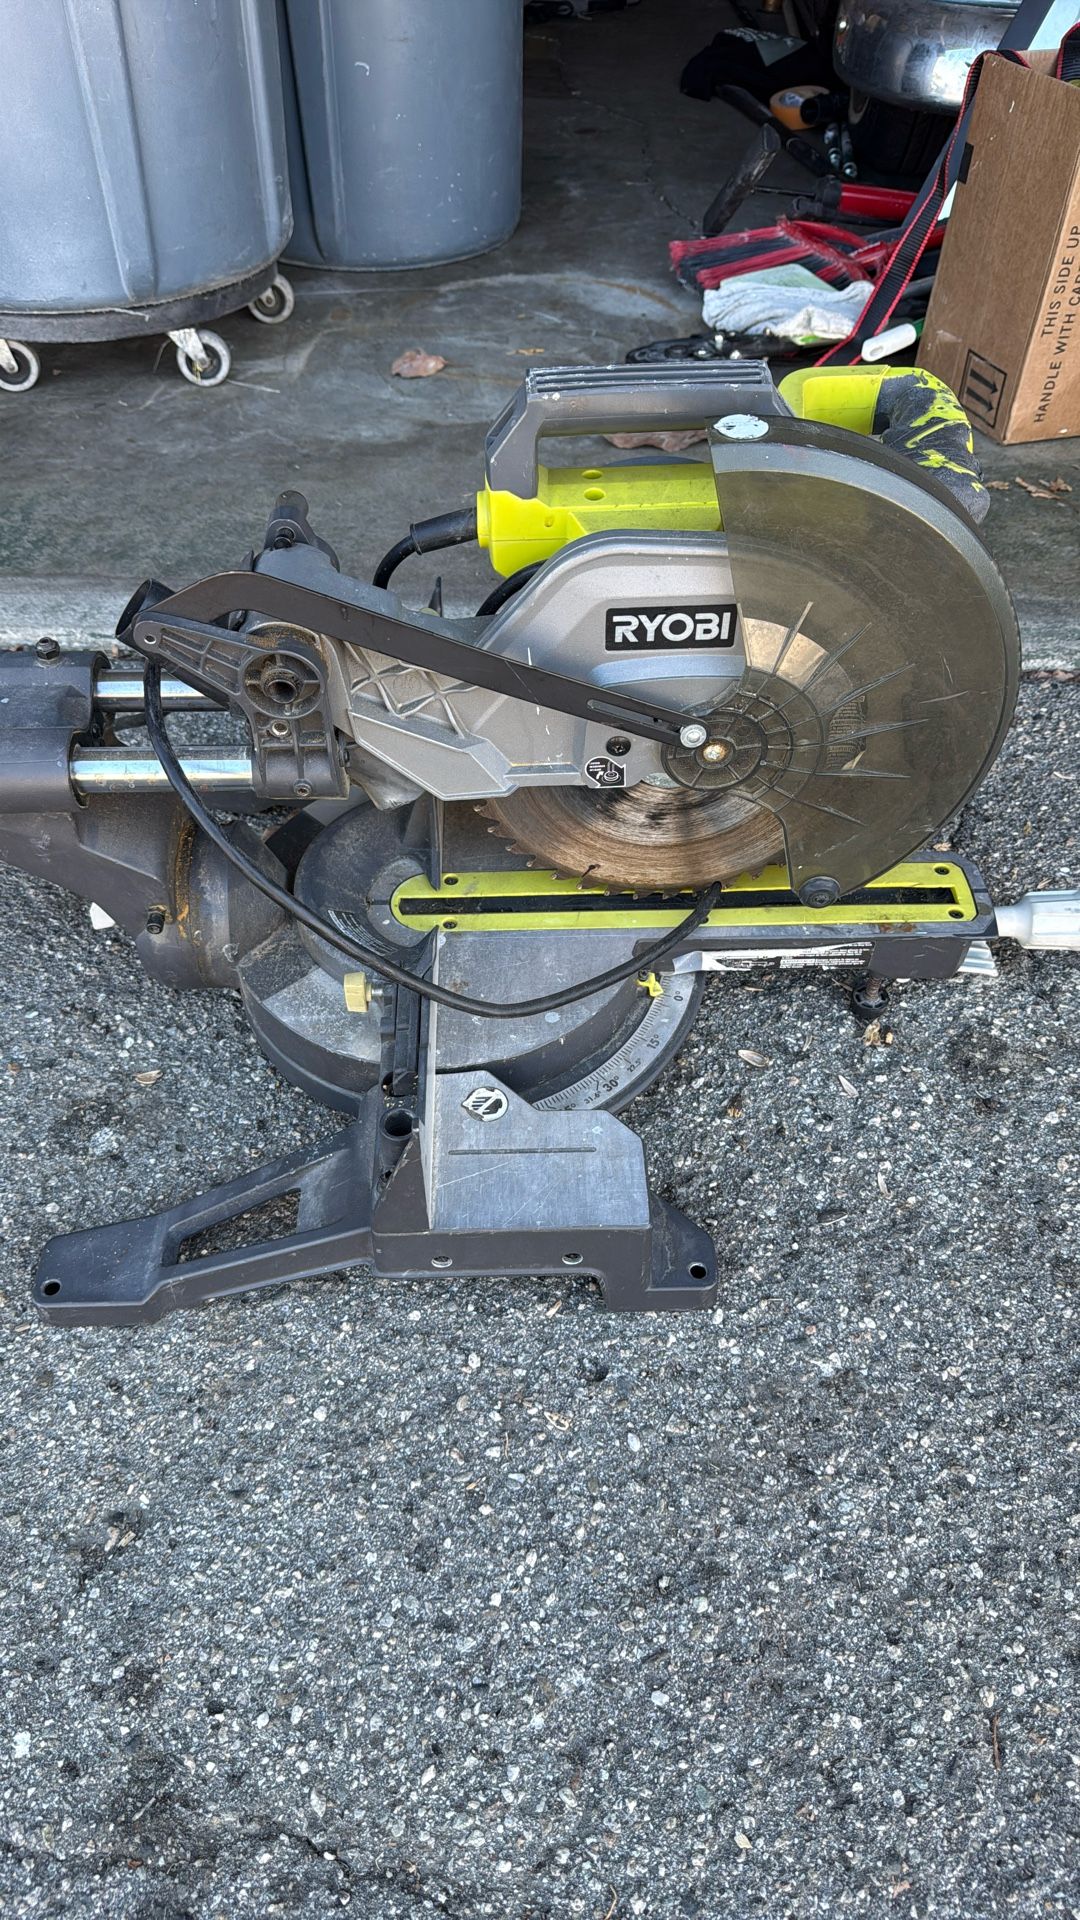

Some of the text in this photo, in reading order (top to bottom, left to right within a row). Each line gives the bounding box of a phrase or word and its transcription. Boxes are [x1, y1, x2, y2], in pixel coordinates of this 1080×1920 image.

[1041, 225, 1080, 338] THIS SIDE UP
[1034, 361, 1062, 423] HANDLE
[1054, 313, 1077, 356] WITH
[612, 611, 731, 643] RYOBI
[646, 1034, 660, 1050] 15°
[602, 1076, 620, 1092] 30°
